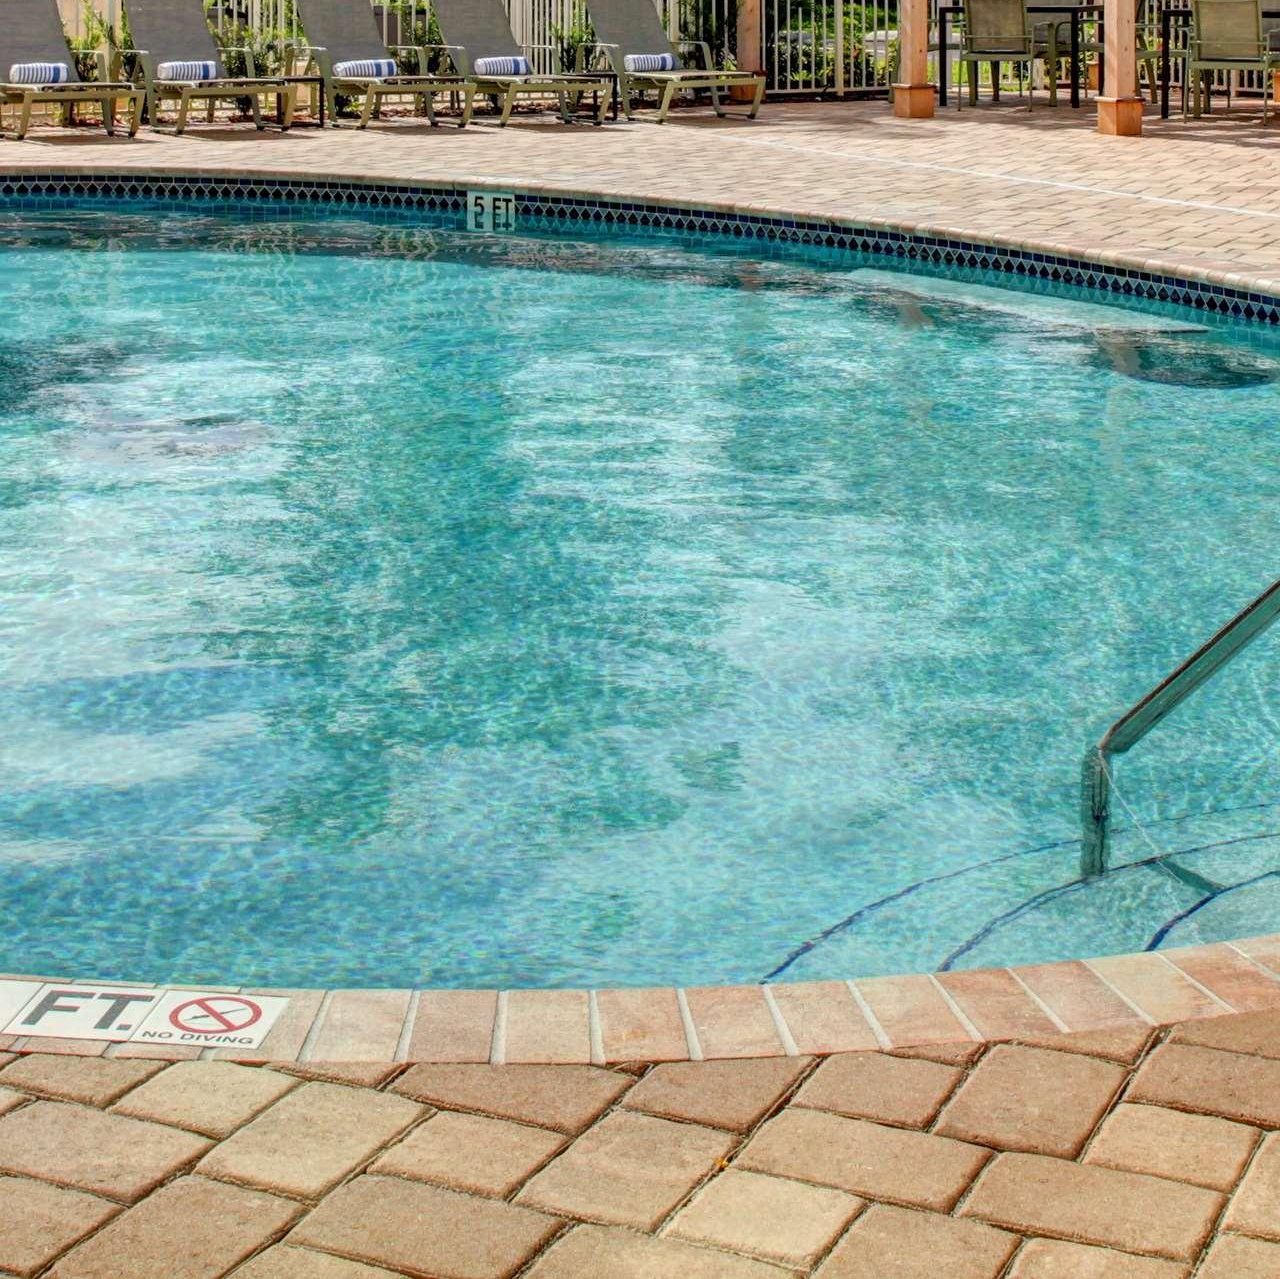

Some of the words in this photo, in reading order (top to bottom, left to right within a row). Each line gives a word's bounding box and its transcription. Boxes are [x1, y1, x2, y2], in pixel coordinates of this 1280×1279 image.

[474, 196, 485, 216] 5
[21, 990, 156, 1031] FT.
[142, 1030, 174, 1040] NO
[180, 1033, 254, 1045] DIVING
